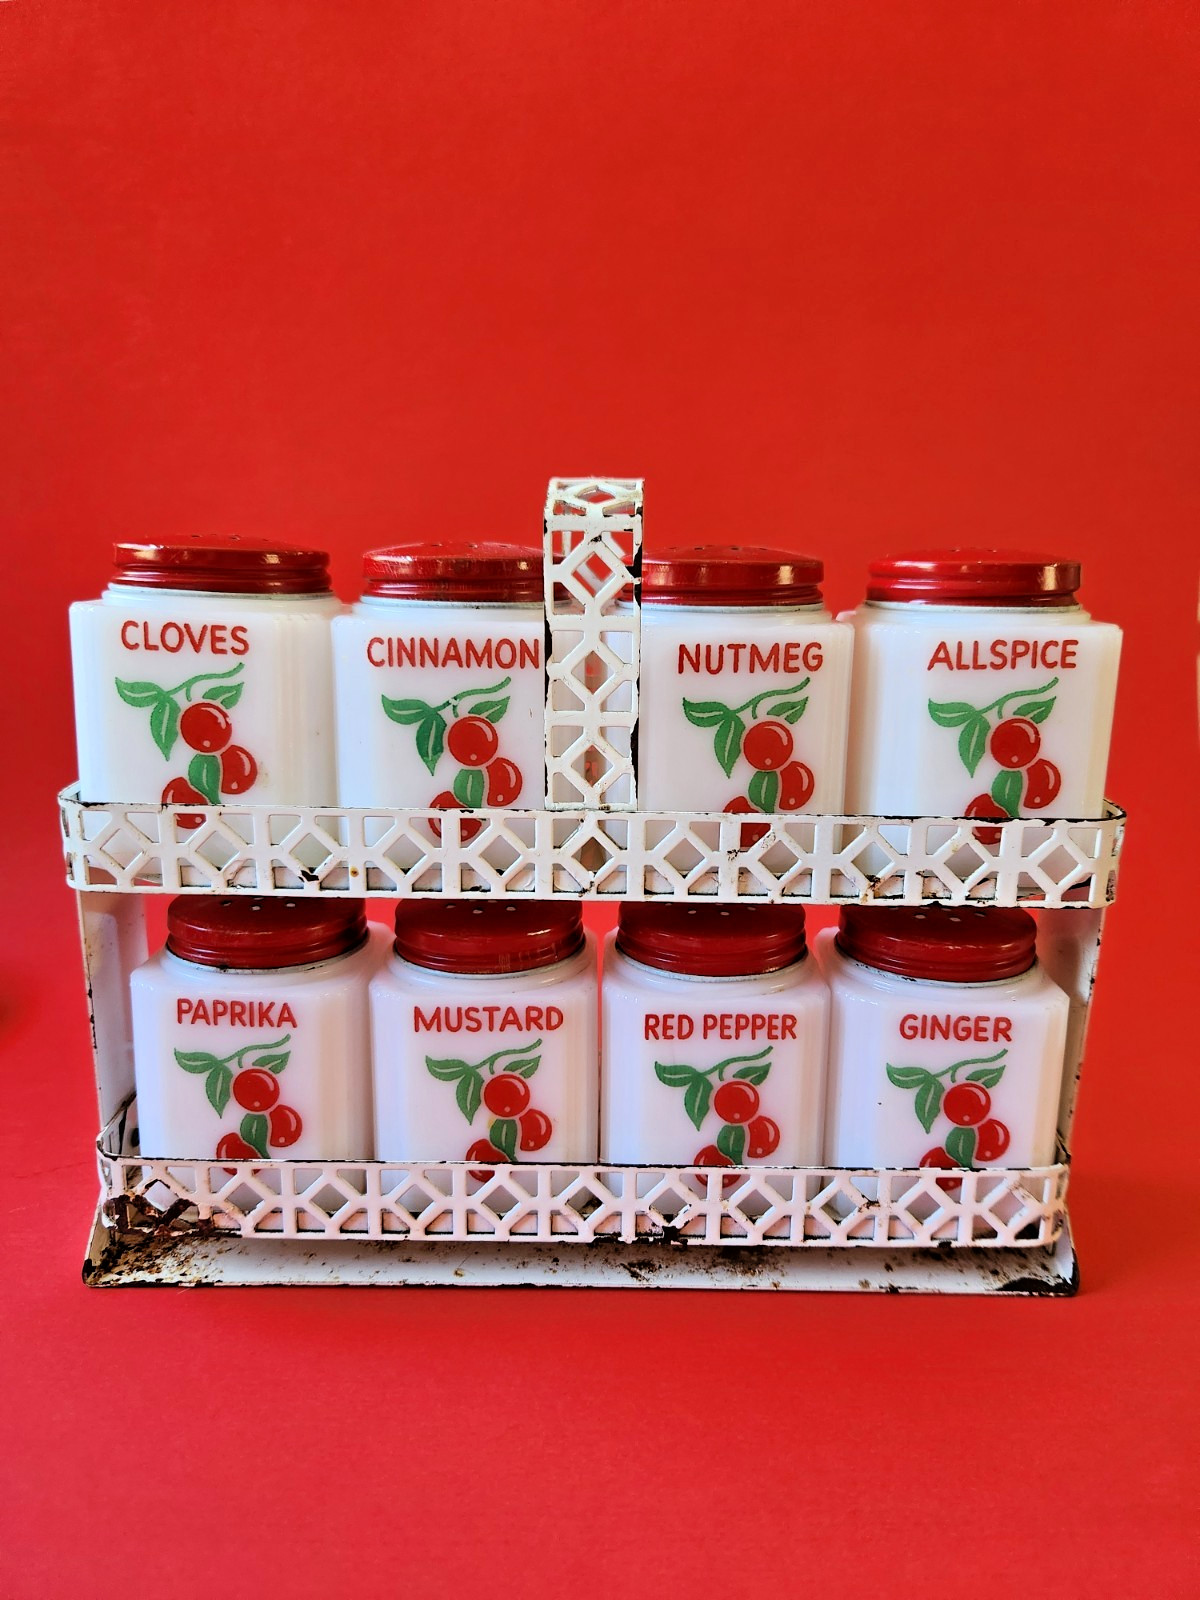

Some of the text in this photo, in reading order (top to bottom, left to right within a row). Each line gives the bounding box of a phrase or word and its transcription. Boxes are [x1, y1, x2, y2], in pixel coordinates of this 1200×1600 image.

[121, 620, 249, 655] CLOVES
[367, 637, 540, 669] CINNAMON
[678, 642, 823, 675] NUTMEG
[928, 639, 1078, 670] ALLSPICE
[176, 997, 297, 1028] PAPRIKA
[414, 1006, 564, 1033] MUSTARD
[644, 1013, 798, 1041] RED PEPPER
[899, 1014, 1012, 1042] GINGER
